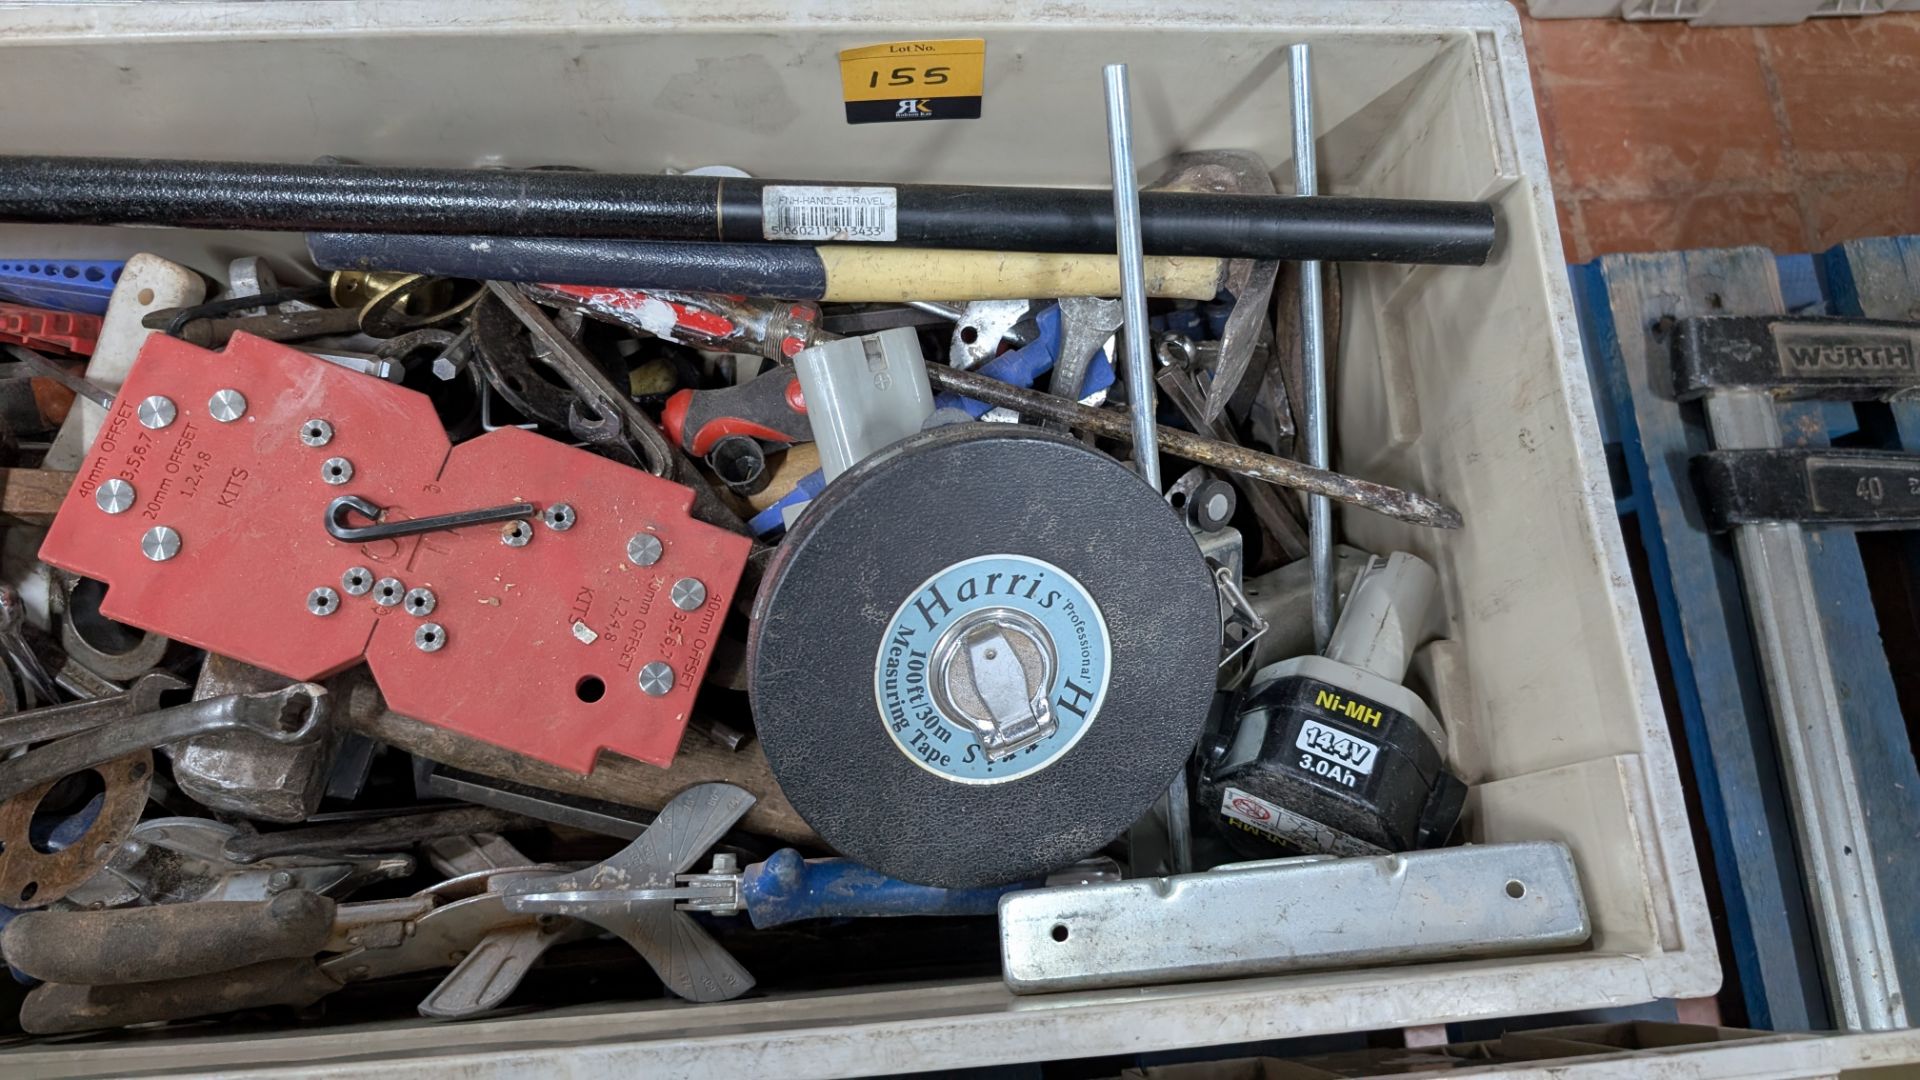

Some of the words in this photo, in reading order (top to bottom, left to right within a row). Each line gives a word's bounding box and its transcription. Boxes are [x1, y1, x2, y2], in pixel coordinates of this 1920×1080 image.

[890, 44, 911, 53] Lot
[914, 44, 936, 52] No.
[869, 67, 951, 89] 155
[78, 455, 108, 499] 40mm
[100, 400, 134, 453] OFFSET
[120, 432, 153, 481] 3,5,6,7
[142, 477, 173, 520] 20mm
[166, 422, 199, 474] OFFSET
[180, 451, 212, 499] 1,2,4,8
[218, 466, 249, 509] KITS
[1856, 476, 1884, 501] 40
[568, 586, 595, 625] KITS
[699, 594, 722, 634] 40mm
[913, 572, 1062, 632] Harris
[618, 619, 647, 672] OFFSET
[679, 638, 707, 692] OFFSET
[885, 624, 915, 734] Measuring
[909, 728, 951, 767] Tape
[906, 650, 952, 744] 100ft/30m
[1315, 690, 1383, 728] Ni-MH
[1305, 726, 1370, 767] 14.4V
[1299, 753, 1356, 788] 3.0Ah
